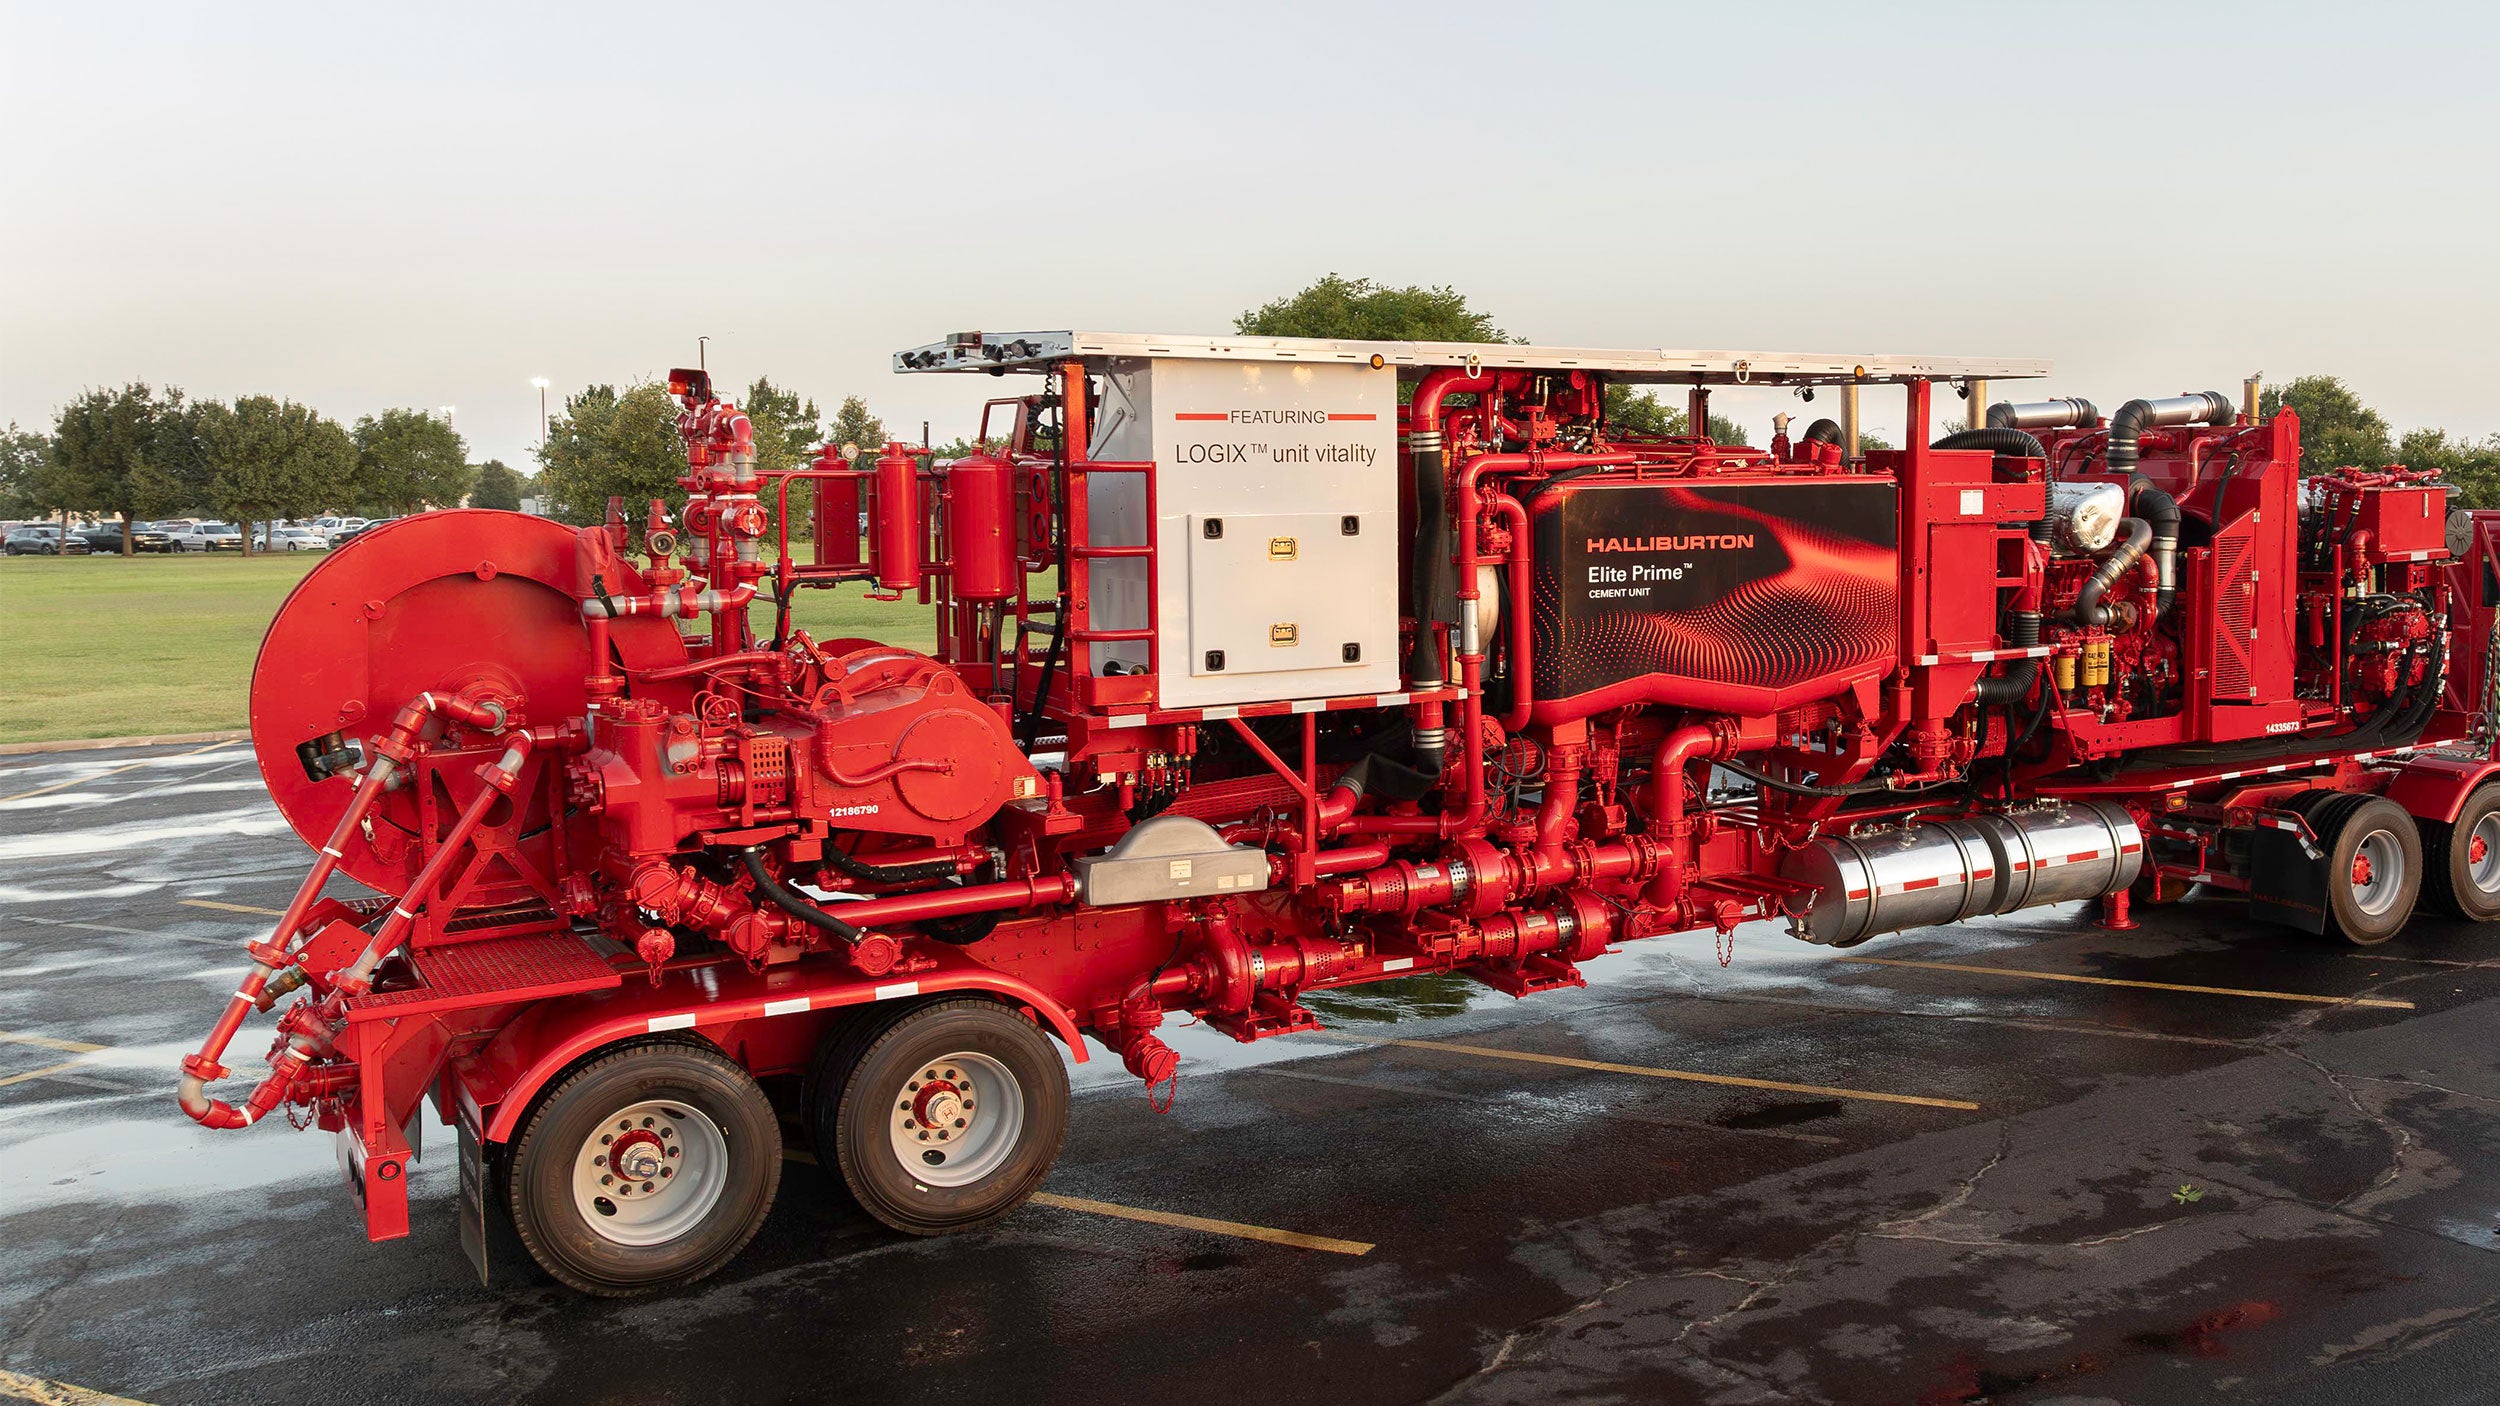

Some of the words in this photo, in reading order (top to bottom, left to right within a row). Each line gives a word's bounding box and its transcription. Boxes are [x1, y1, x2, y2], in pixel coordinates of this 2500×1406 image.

[1231, 410, 1326, 424] FEATURING
[1273, 444, 1310, 463] unit
[1315, 443, 1377, 467] vitality
[1587, 534, 1755, 553] HALLIBURTON
[1588, 566, 1627, 583] Elite
[1588, 588, 1627, 599] CEMENT
[1628, 587, 1651, 597] UNIT
[2265, 721, 2300, 734] 14335673
[829, 804, 879, 817] 12186790
